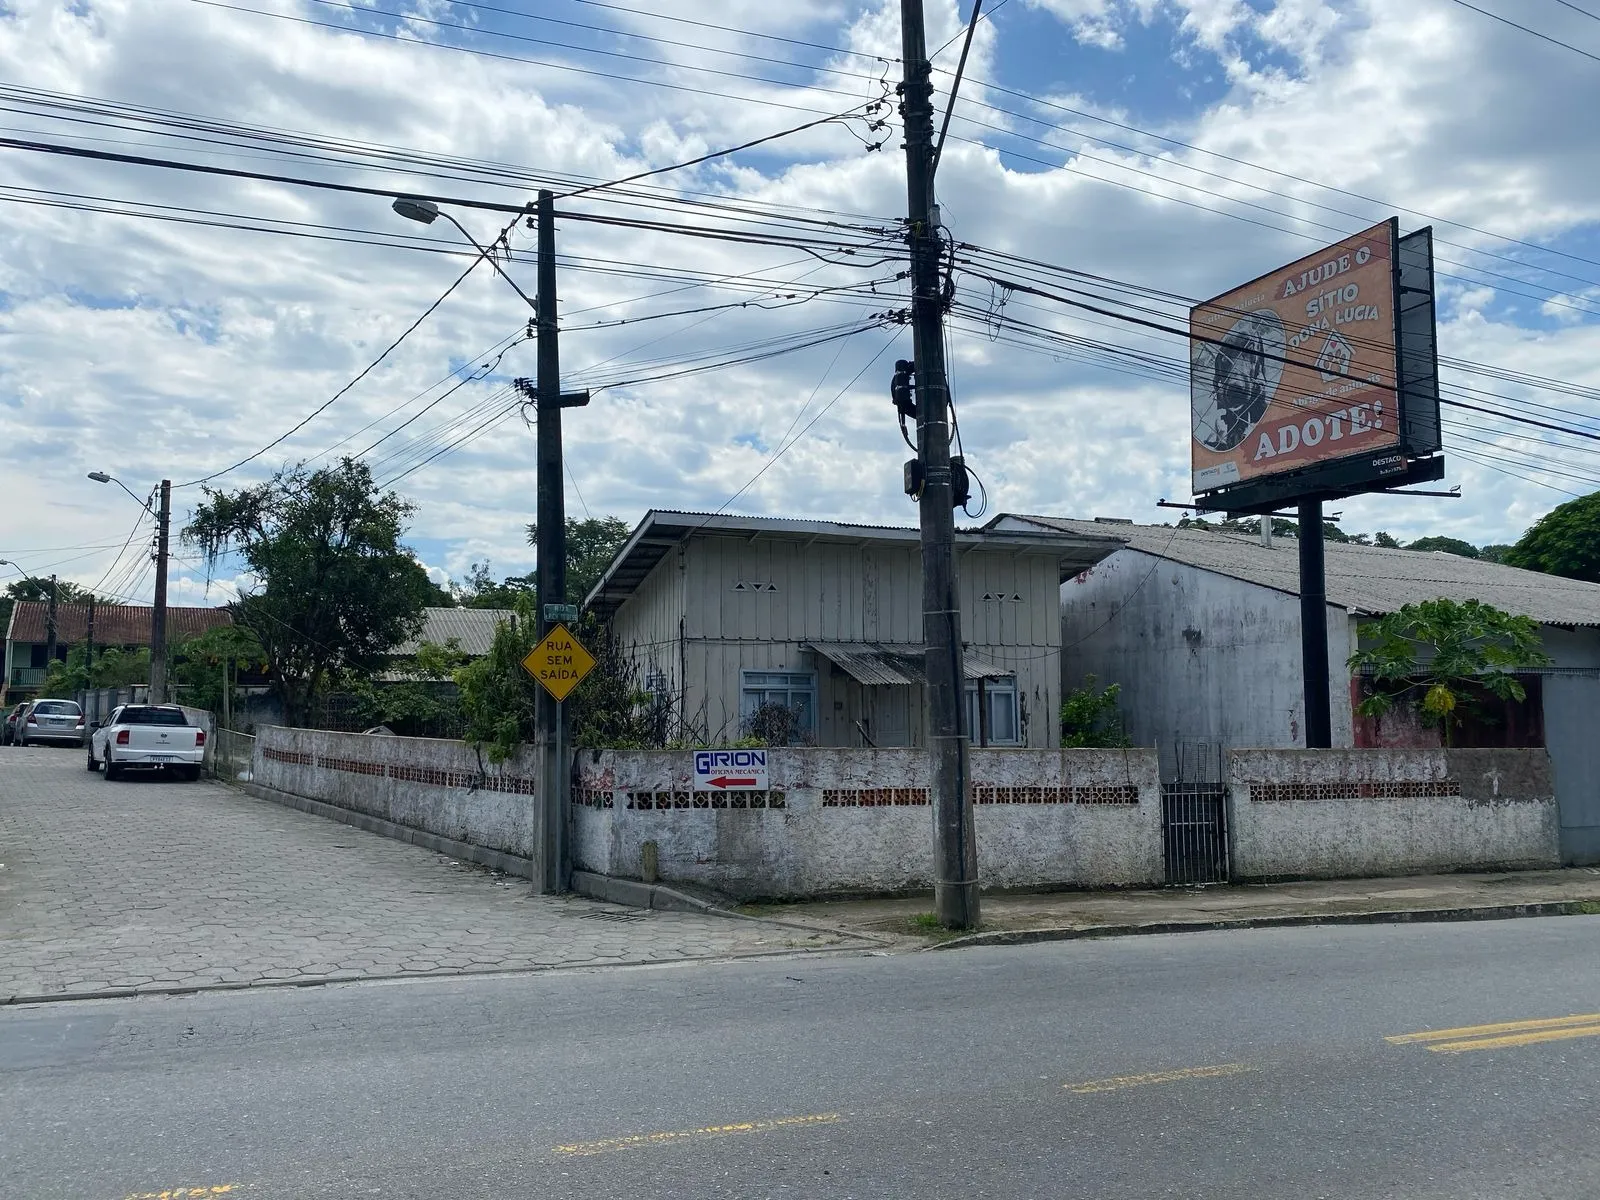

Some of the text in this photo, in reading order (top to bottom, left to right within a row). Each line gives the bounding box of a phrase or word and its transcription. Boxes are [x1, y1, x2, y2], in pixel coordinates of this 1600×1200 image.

[1283, 246, 1371, 298] AJUDE O
[1306, 283, 1359, 318] SÍTIO
[1254, 400, 1384, 461] ADOTE!
[547, 641, 573, 651] RUA
[547, 656, 573, 665] SEM
[540, 667, 579, 680] SAÍDA
[695, 751, 766, 775] GIRION
